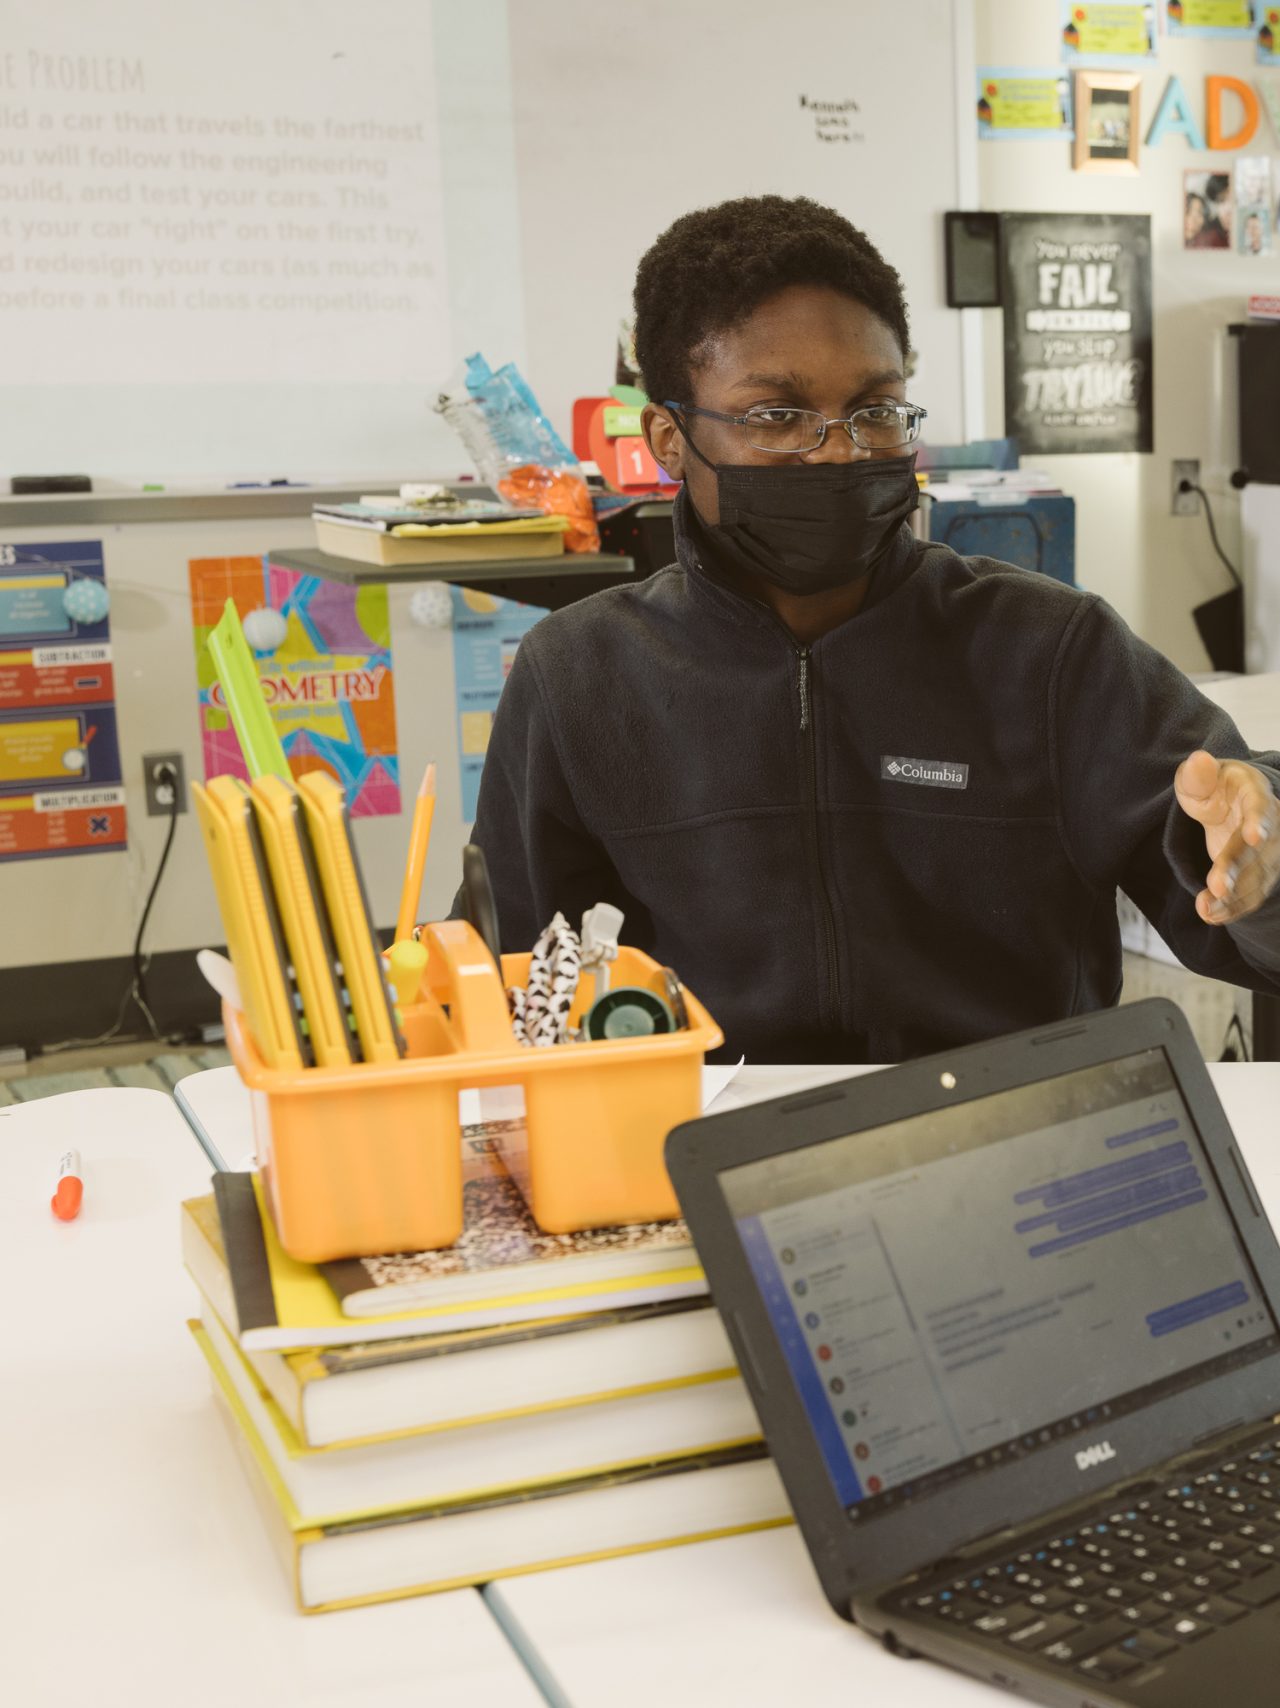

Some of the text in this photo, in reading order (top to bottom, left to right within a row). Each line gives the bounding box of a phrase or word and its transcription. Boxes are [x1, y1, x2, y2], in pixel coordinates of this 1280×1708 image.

[28, 48, 146, 94] PROBLEM
[37, 112, 54, 130] a
[62, 112, 106, 132] car
[114, 110, 167, 134] that
[176, 113, 265, 138] travels
[274, 115, 316, 139] the
[323, 116, 424, 142] farthest
[33, 145, 80, 167] will
[88, 146, 172, 169] follow
[180, 148, 223, 171] the
[232, 150, 389, 180] engineering
[80, 181, 131, 205] and
[140, 183, 192, 206] test
[199, 188, 257, 210] your
[266, 188, 327, 208] cars.
[336, 185, 390, 210] This
[20, 219, 81, 243] your
[91, 220, 131, 239] car
[236, 223, 269, 242] on
[277, 220, 319, 242] the
[327, 220, 376, 244] first
[385, 223, 424, 247] try.
[24, 252, 142, 279] redesign
[151, 257, 210, 280] your
[220, 257, 274, 277] cars
[282, 255, 320, 279] (as
[329, 254, 399, 278] much
[405, 260, 436, 280] as
[1037, 262, 1119, 308] FAIL
[92, 291, 110, 310] a
[118, 286, 176, 310] final
[184, 288, 251, 311] class
[258, 289, 420, 317] competition.
[1021, 360, 1139, 412] TRYING
[630, 450, 643, 476] 1
[39, 649, 106, 664] SUBTRACTION
[211, 664, 386, 706] GOMETRY
[901, 763, 963, 783] Columbia
[40, 791, 119, 807] MULTIPLICATION
[1075, 1440, 1116, 1470] DELL
